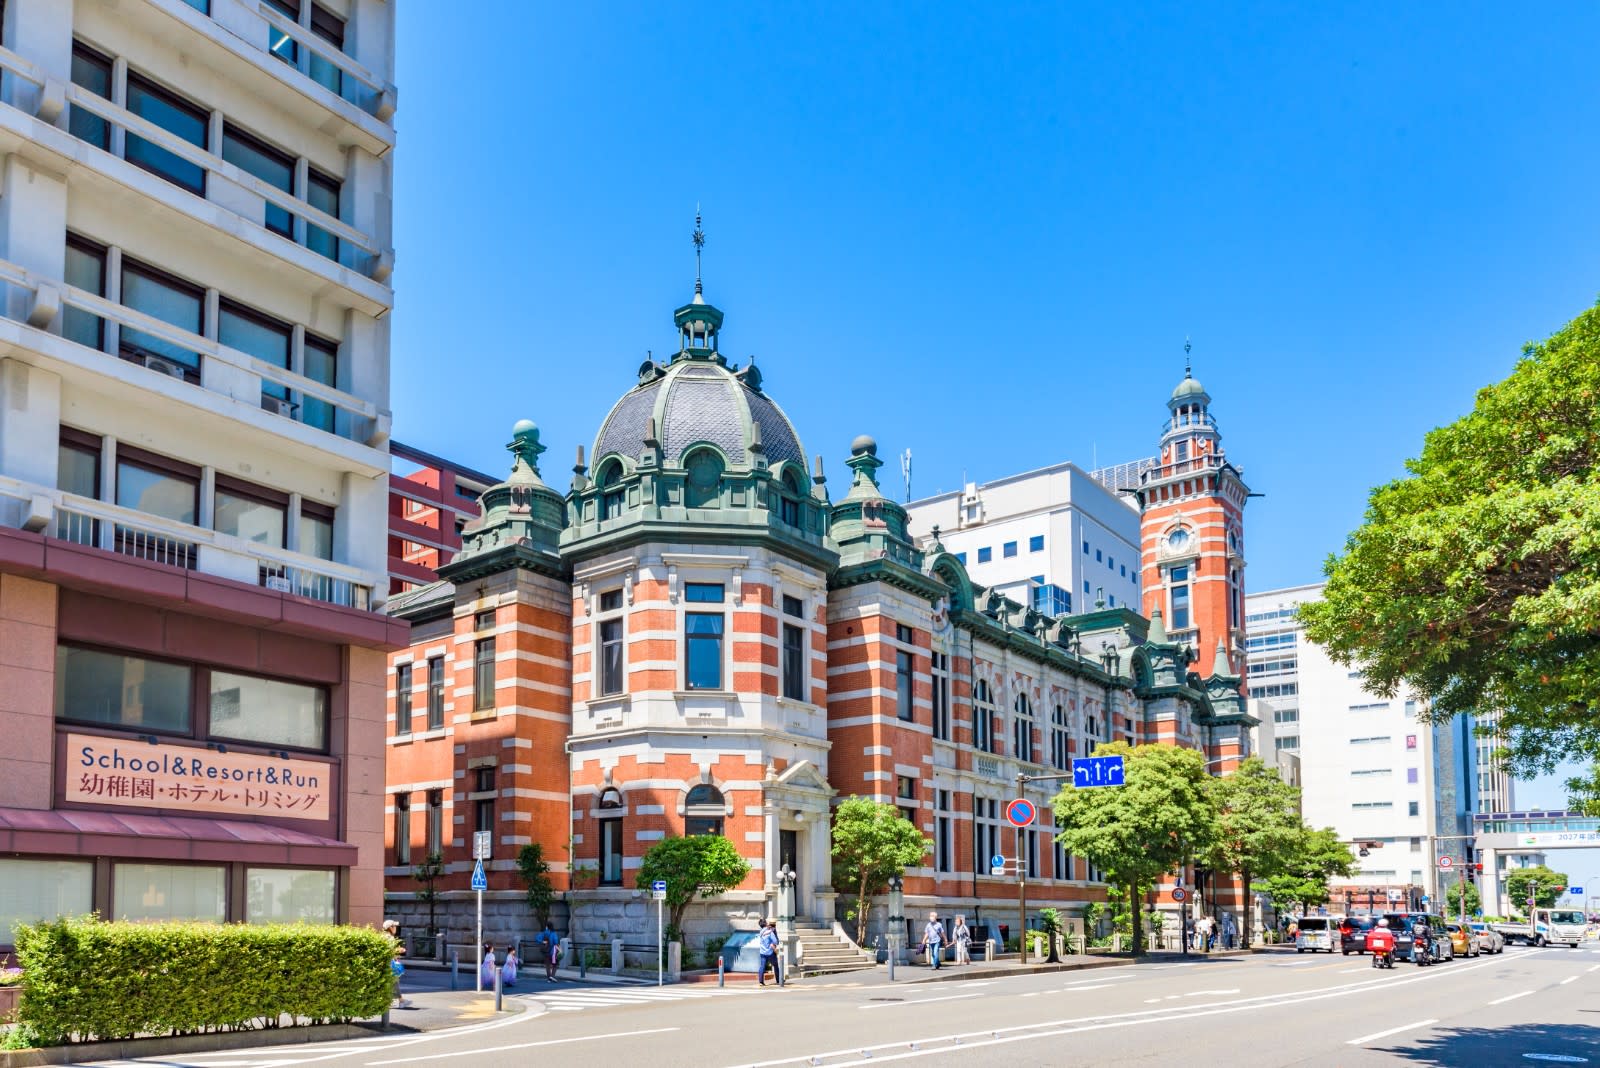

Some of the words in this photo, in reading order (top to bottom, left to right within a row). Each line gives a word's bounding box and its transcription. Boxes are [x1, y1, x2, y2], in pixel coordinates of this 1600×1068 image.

[81, 746, 318, 788] School&Resort&Run
[79, 772, 320, 811] 幼稚園・ホテル・トリミング
